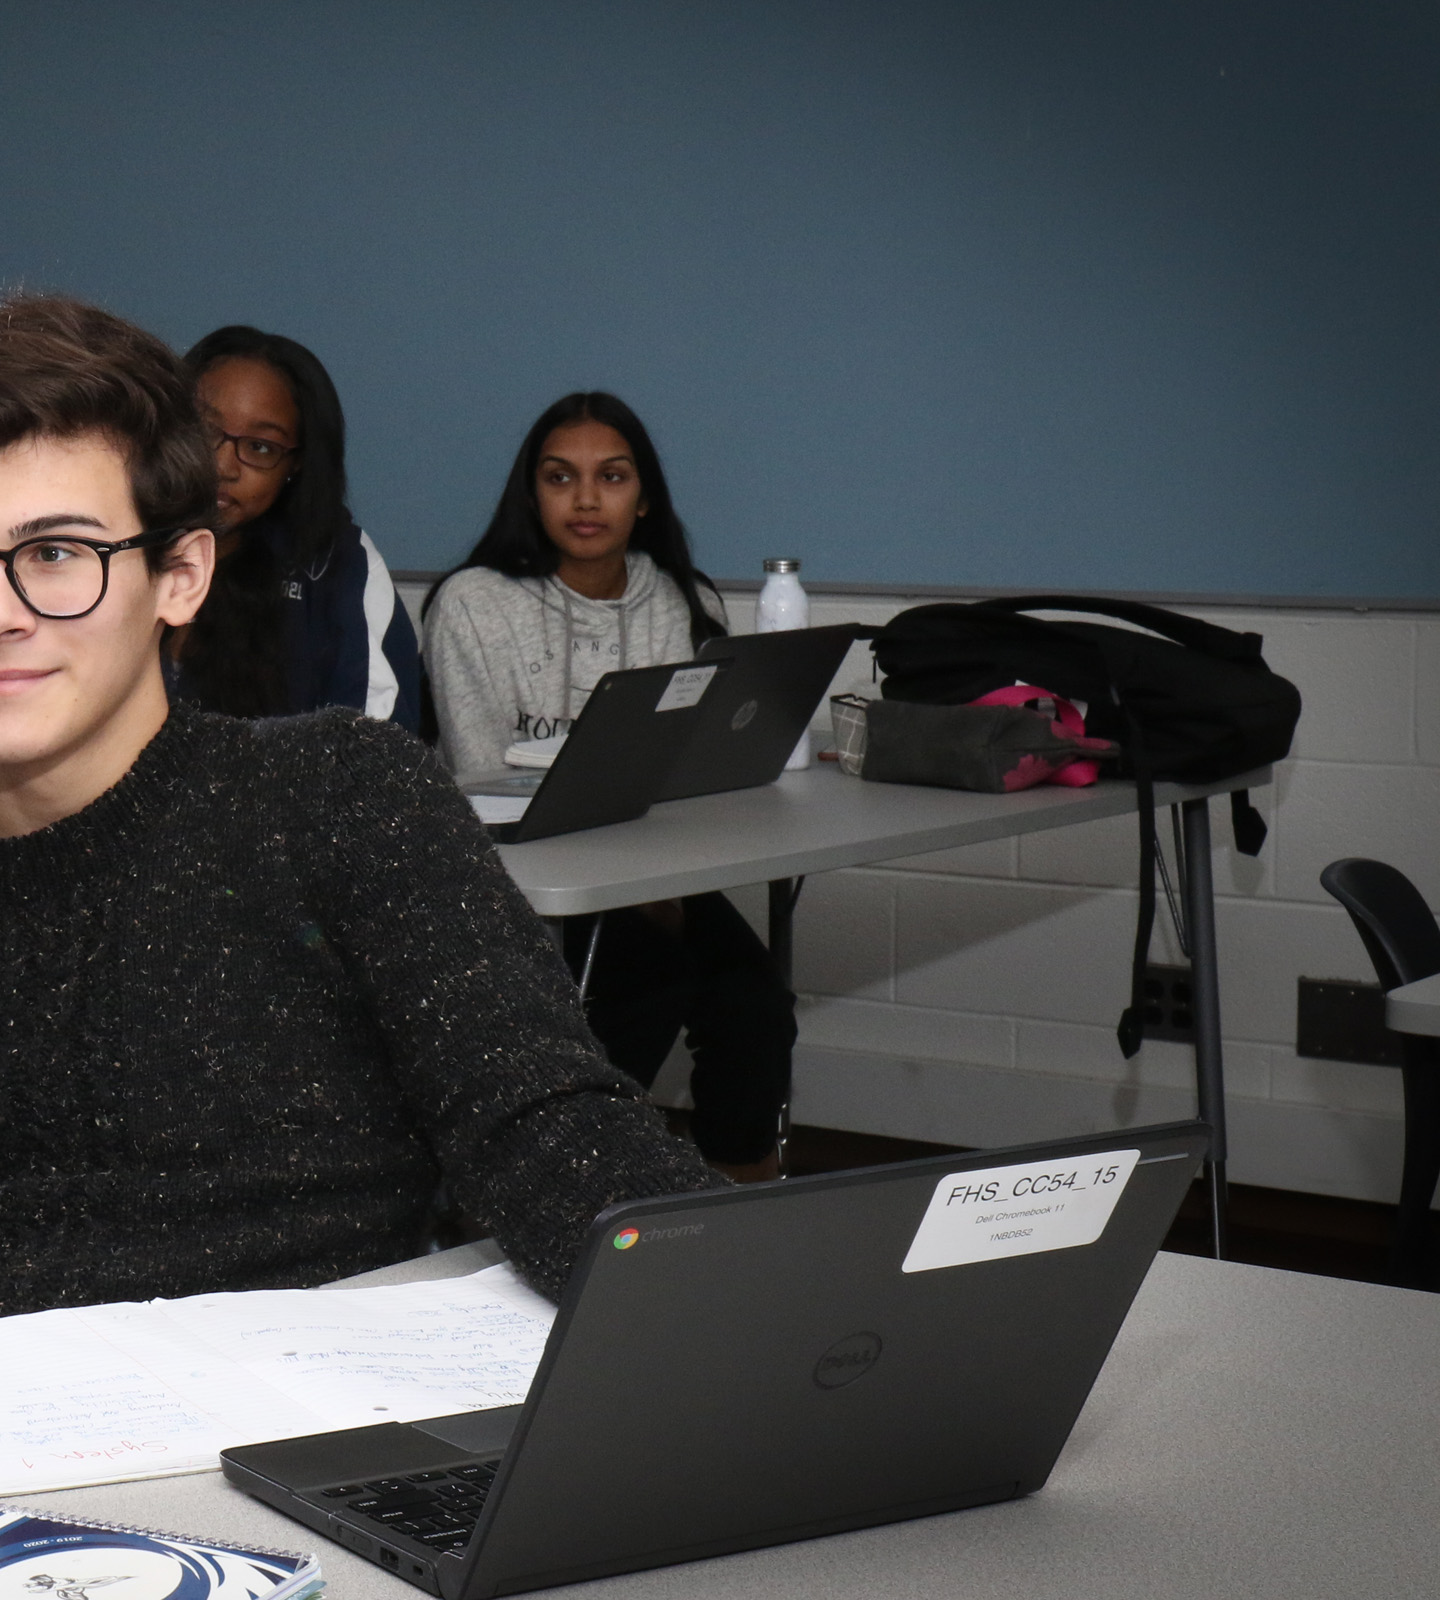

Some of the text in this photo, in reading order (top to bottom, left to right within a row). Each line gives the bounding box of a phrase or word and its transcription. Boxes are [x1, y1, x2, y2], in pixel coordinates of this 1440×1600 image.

[975, 1203, 1066, 1225] Dell Chromebook 11
[641, 1223, 705, 1242] chrome
[51, 1440, 168, 1460] System
[23, 1539, 50, 1548] 2020
